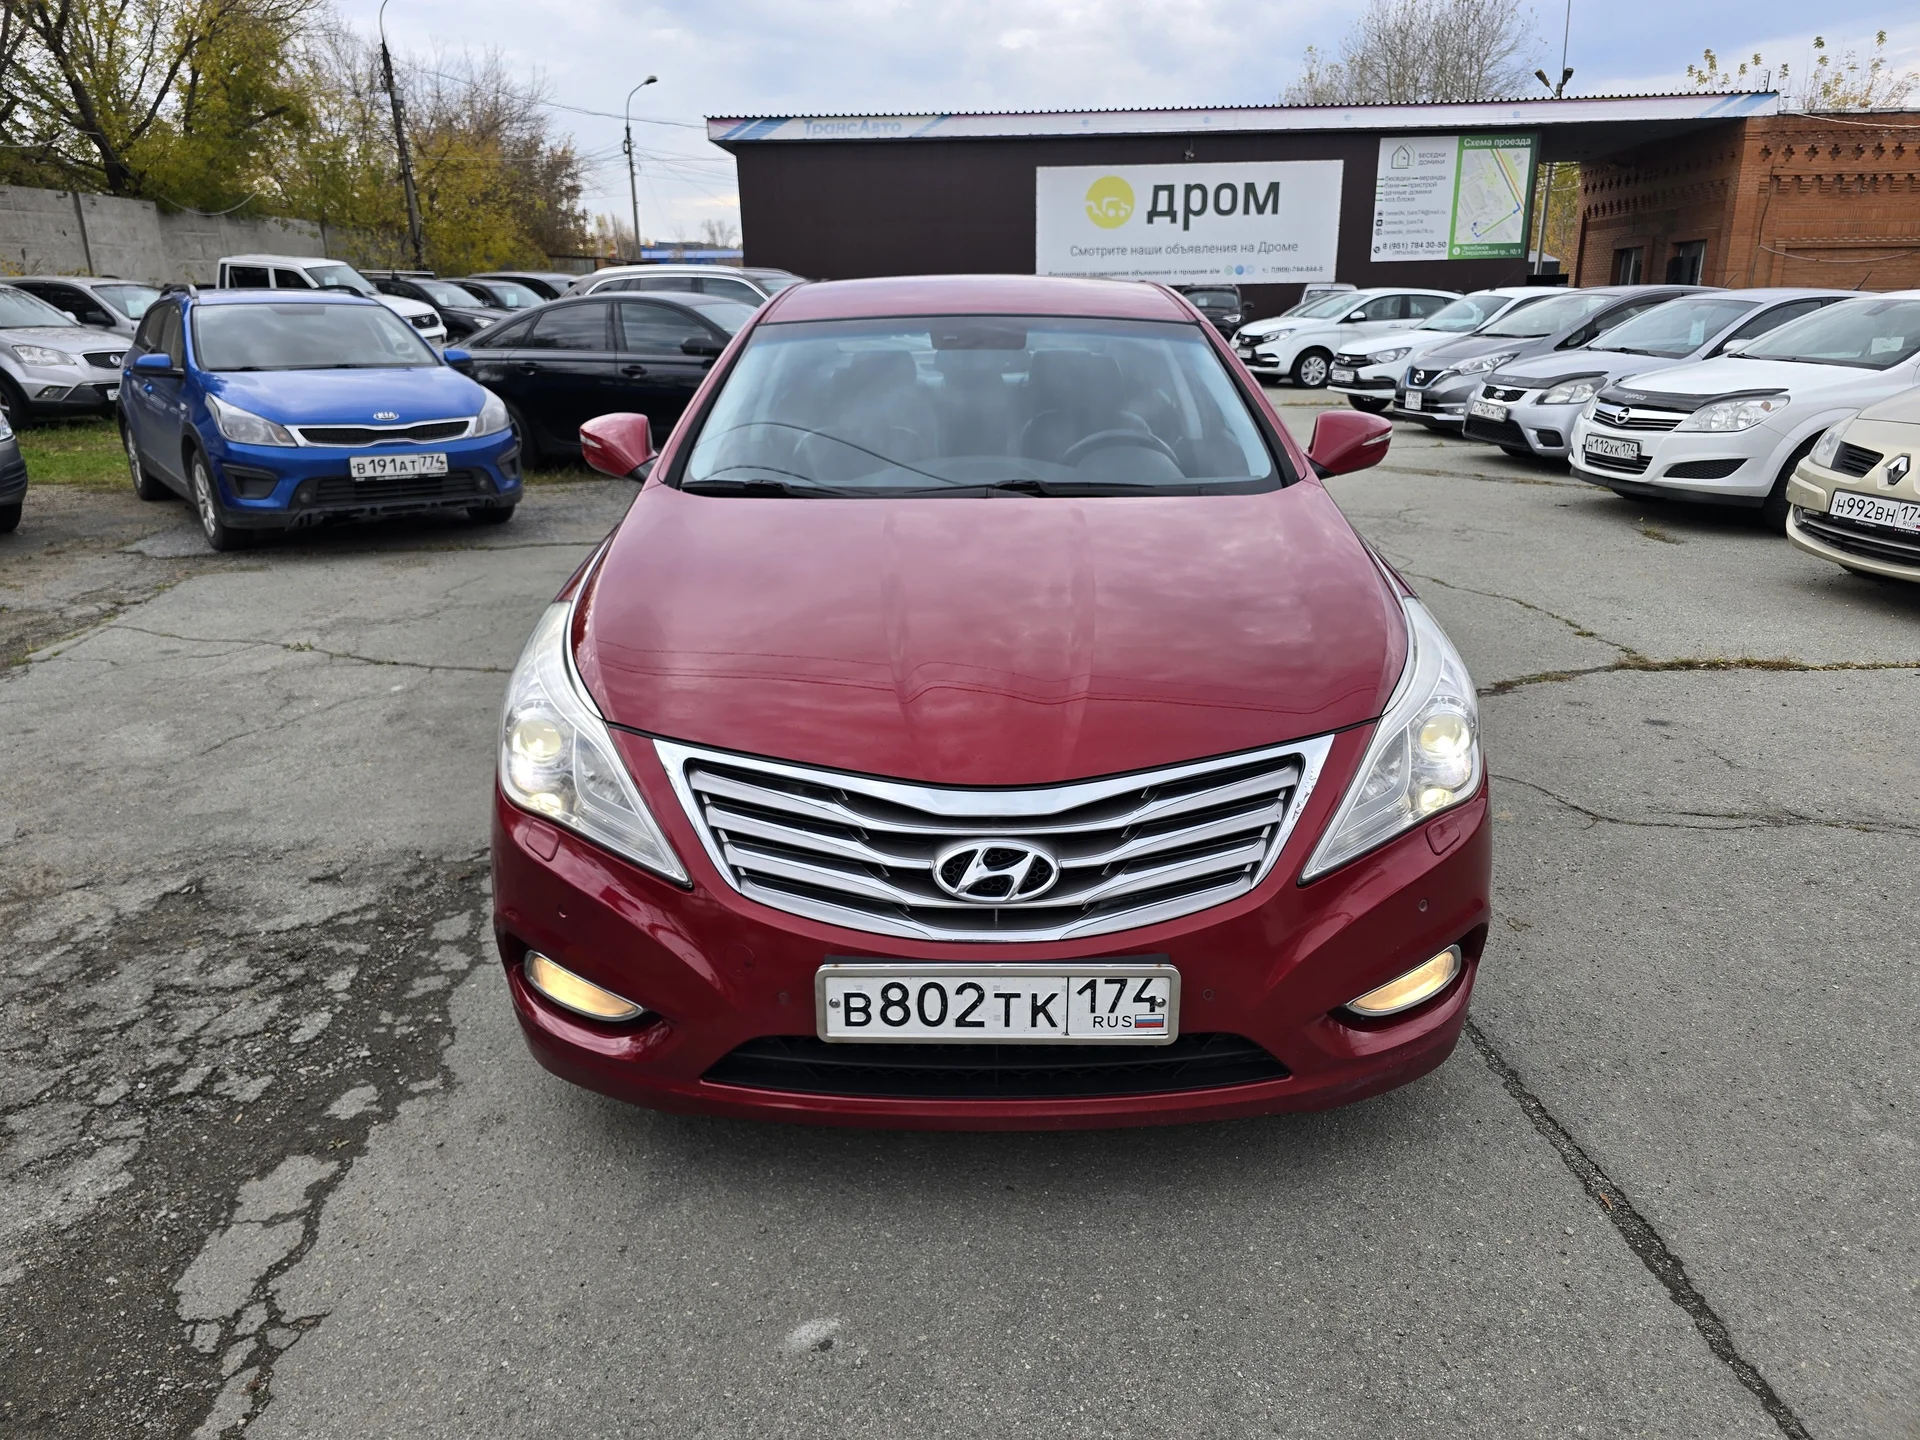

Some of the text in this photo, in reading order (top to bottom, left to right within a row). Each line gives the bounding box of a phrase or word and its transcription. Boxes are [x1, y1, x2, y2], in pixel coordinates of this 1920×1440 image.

[804, 119, 902, 135] ТрансАвто
[1464, 137, 1531, 148] Схема проезда
[1146, 180, 1281, 232] дром
[1070, 240, 1299, 259] Смотрите наши объявления на Дроме
[1588, 438, 1635, 456] Н112ХК 174
[356, 455, 443, 475] В191АТ 774
[1835, 497, 1920, 523] Н992ВН 17
[843, 978, 1157, 1028] В802ТК 174
[1092, 1016, 1132, 1029] RUS
